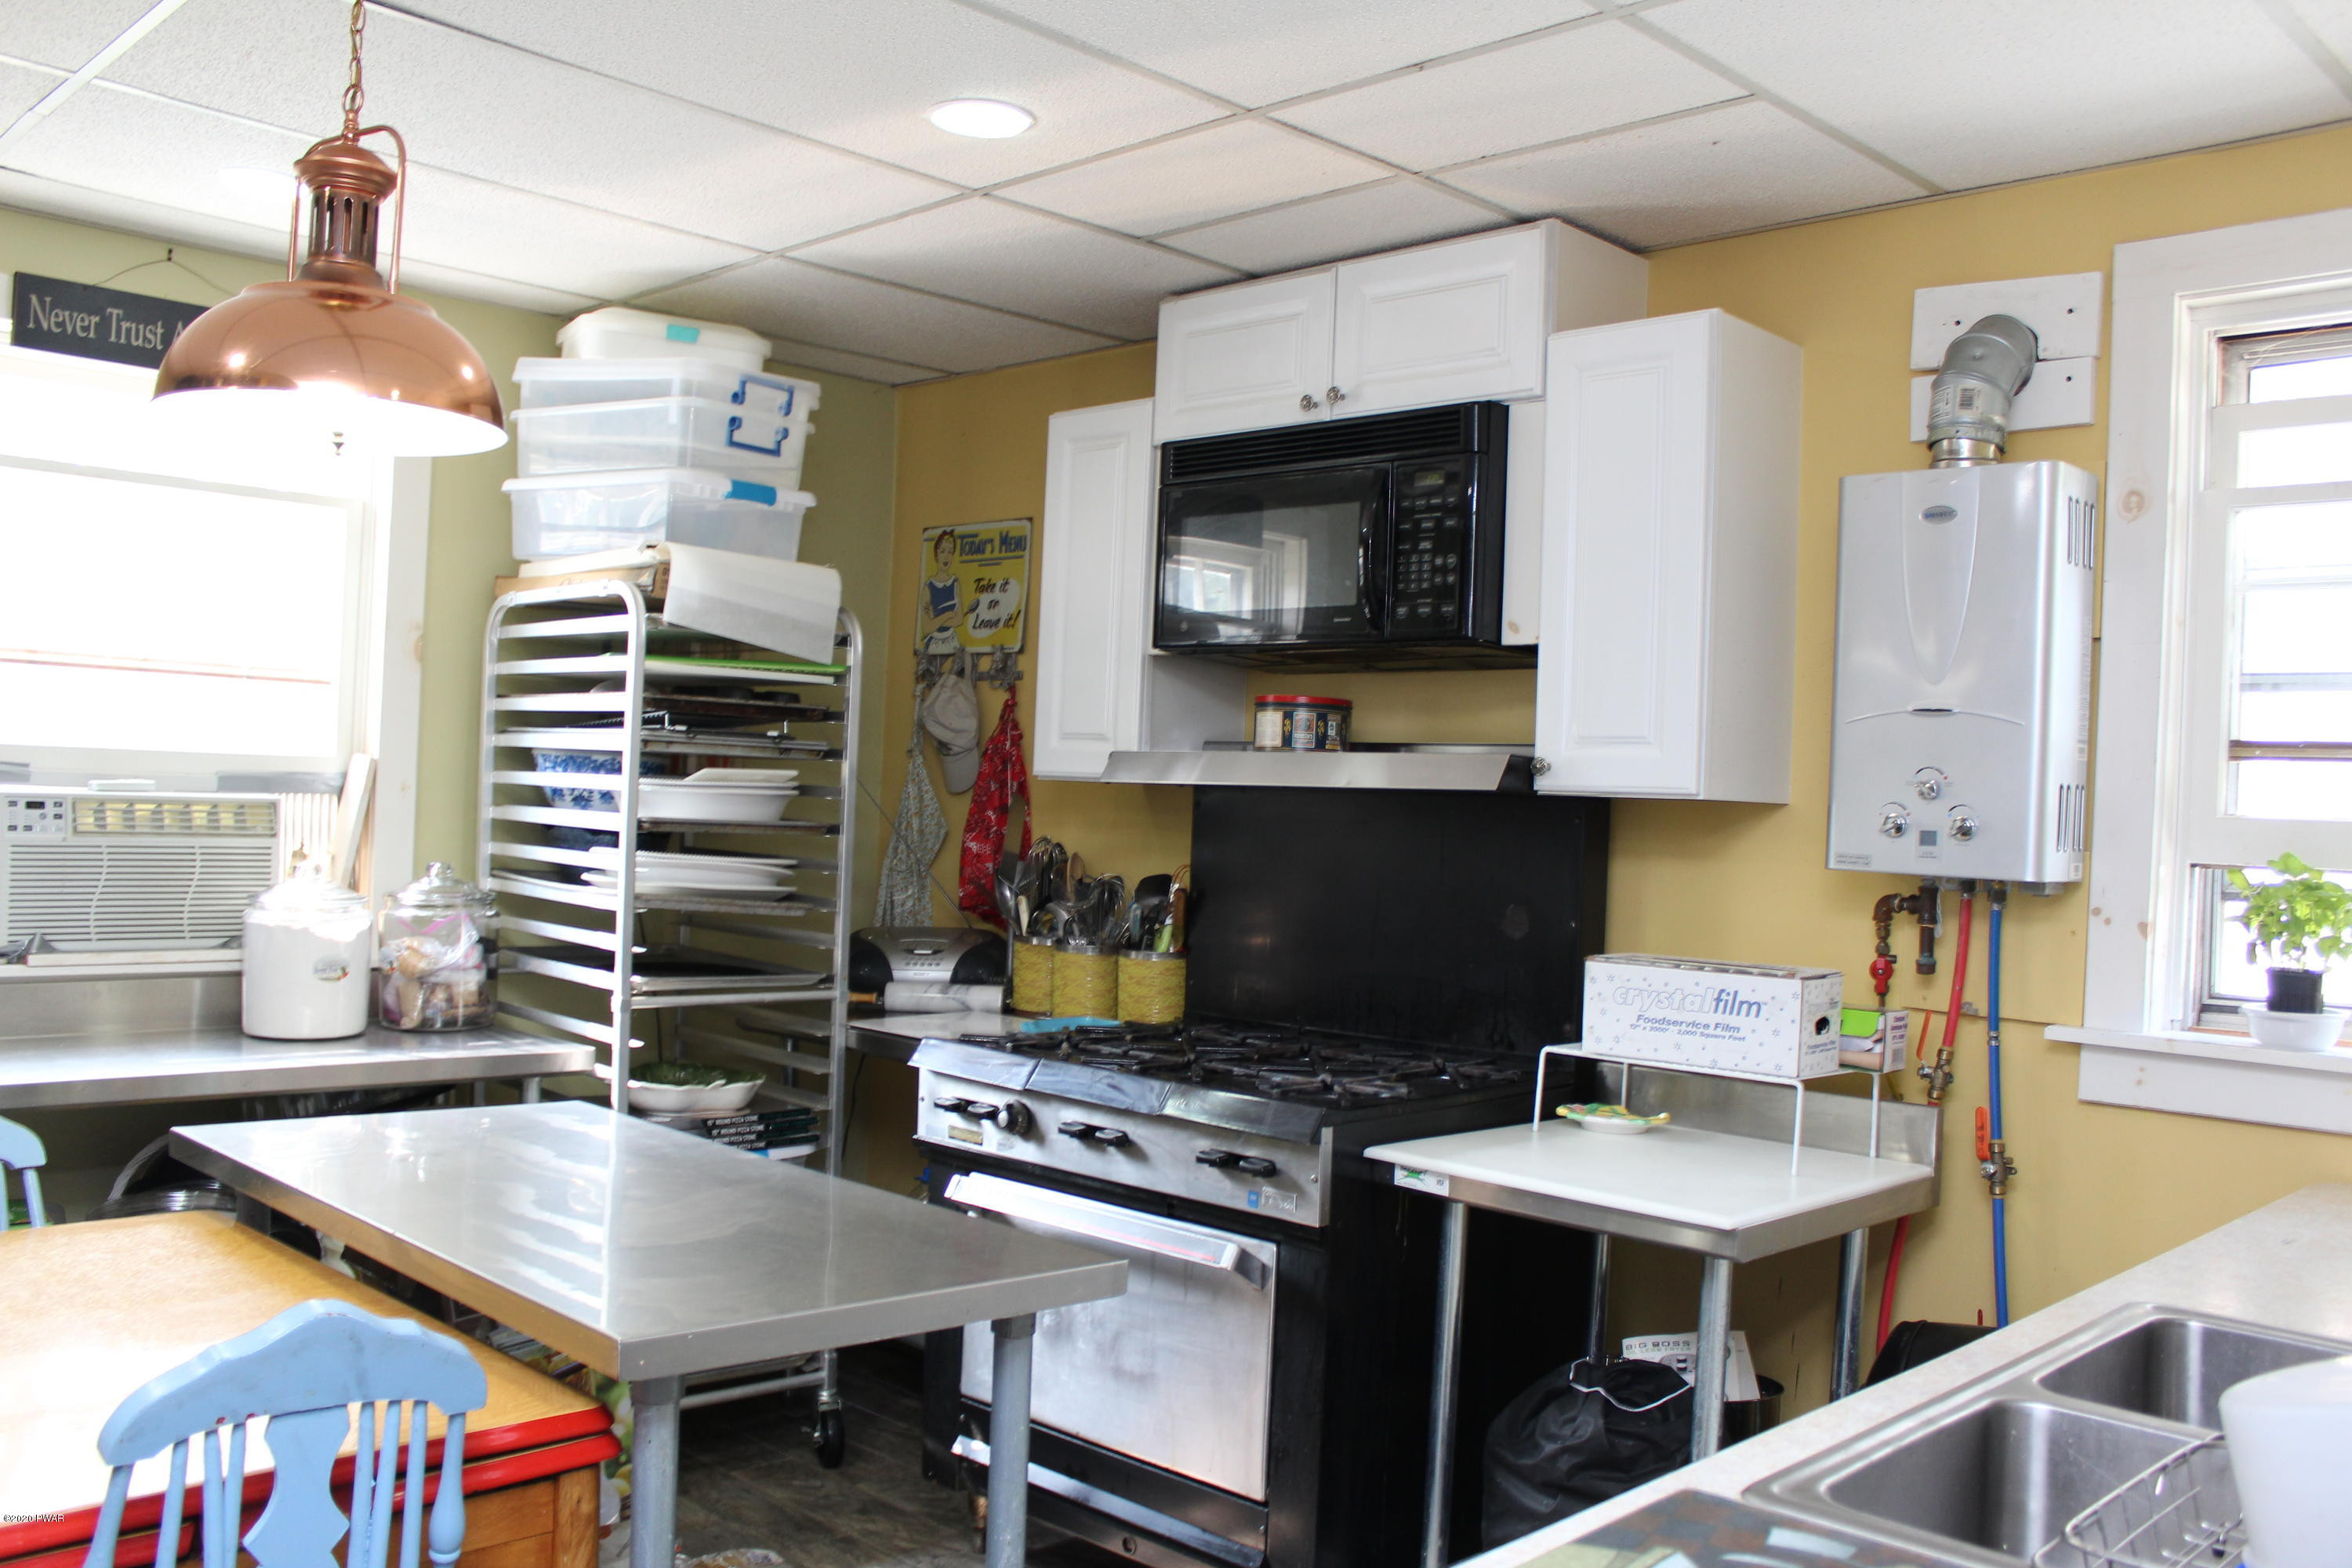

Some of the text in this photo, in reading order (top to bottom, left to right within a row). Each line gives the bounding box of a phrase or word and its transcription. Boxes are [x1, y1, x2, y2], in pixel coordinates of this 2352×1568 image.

[27, 294, 101, 339] Never
[107, 308, 164, 350] Trust
[974, 577, 1010, 594] Take it
[987, 600, 999, 610] or
[972, 609, 1022, 630] Leave it!
[1636, 1014, 1740, 1034] Foodservice Film
